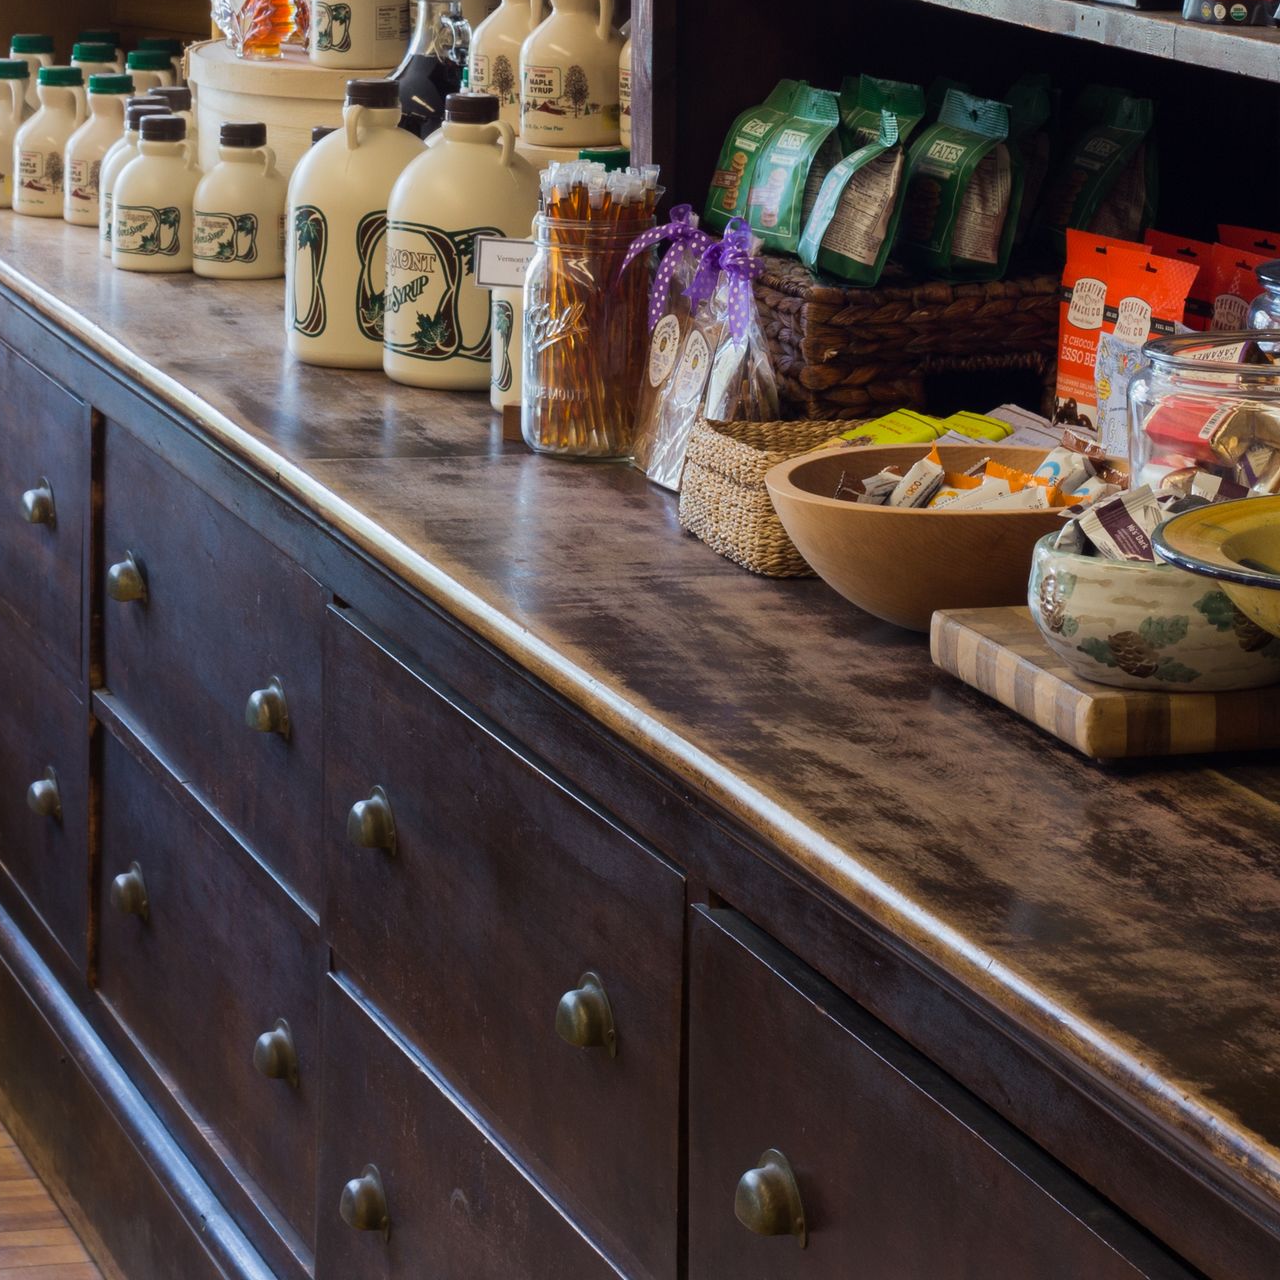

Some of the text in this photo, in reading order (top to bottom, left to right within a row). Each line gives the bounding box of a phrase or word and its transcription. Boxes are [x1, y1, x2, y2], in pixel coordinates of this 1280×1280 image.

[529, 78, 554, 87] MAPLE
[529, 86, 554, 95] SYRUP
[496, 254, 525, 263] Vermont
[392, 275, 430, 314] SYRUP
[1075, 281, 1106, 300] CREATIVE
[1070, 302, 1091, 317] SNACKS
[1120, 301, 1149, 320] CREATIVE
[1192, 346, 1238, 362] CARAMEL
